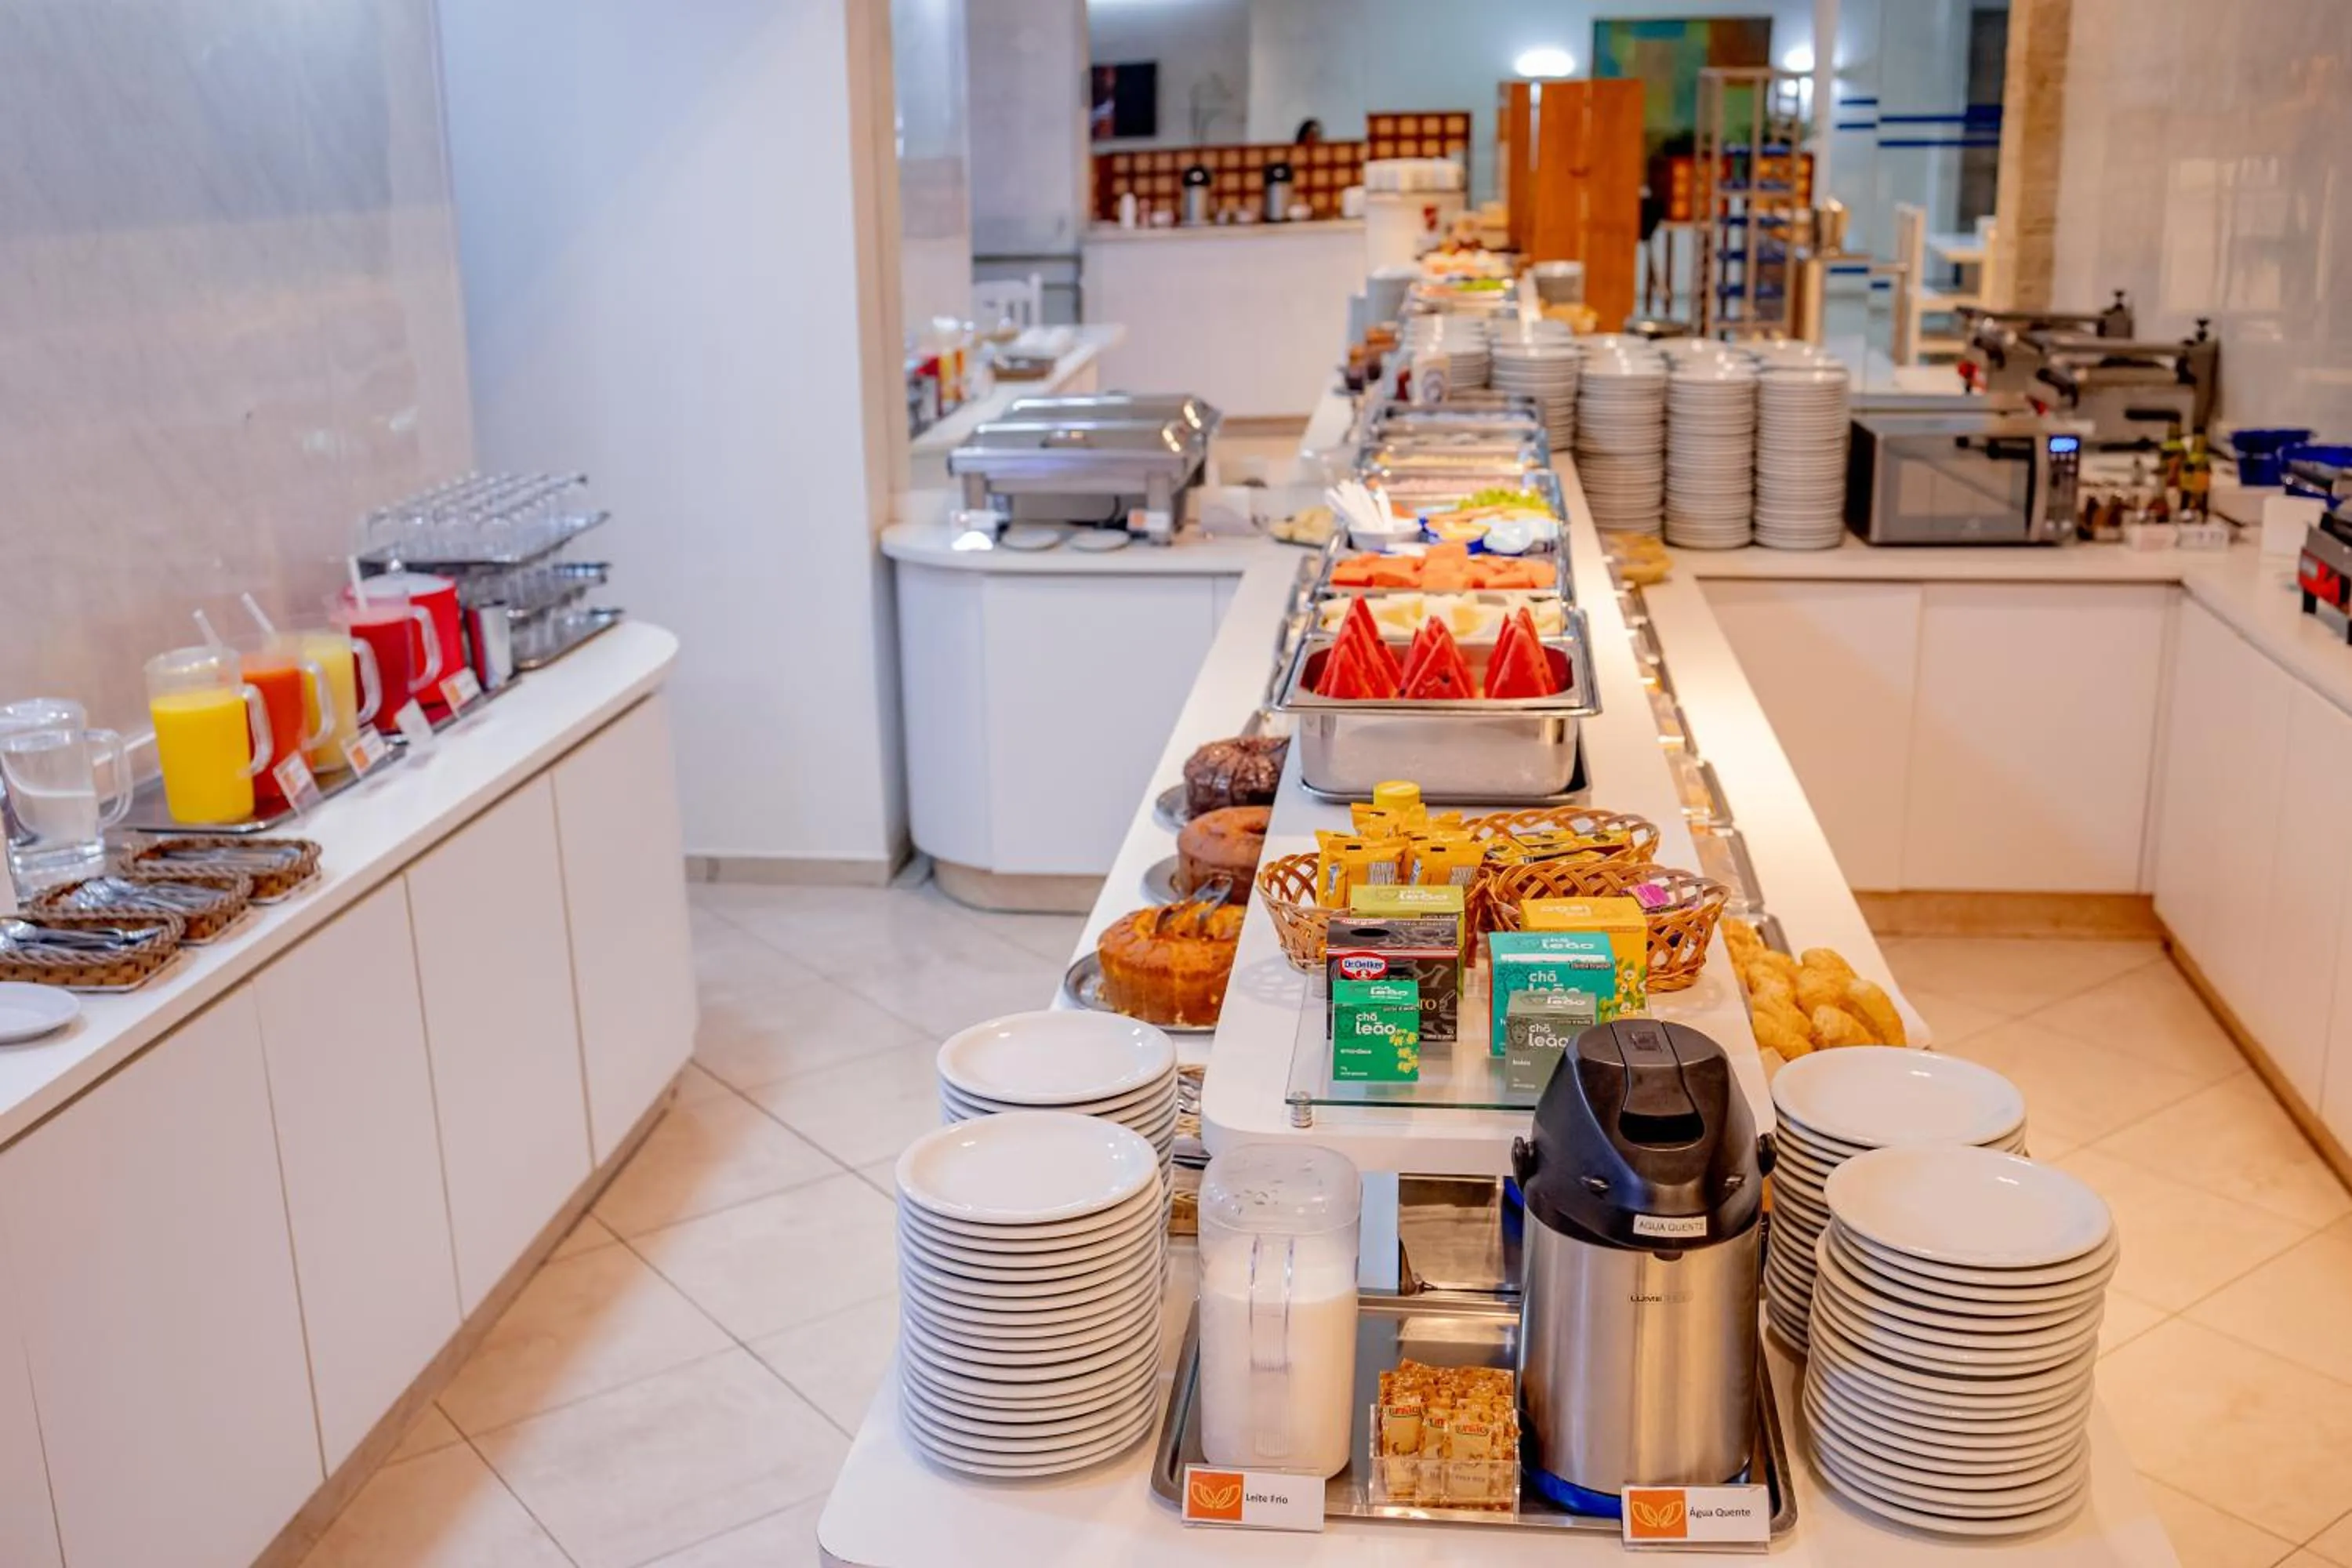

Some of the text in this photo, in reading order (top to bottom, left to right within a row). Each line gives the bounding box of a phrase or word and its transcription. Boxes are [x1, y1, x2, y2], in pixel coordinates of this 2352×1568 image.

[1356, 1021, 1396, 1035] leão
[1529, 1033, 1569, 1048] leão
[1668, 1222, 1704, 1232] QUENTE
[1246, 1493, 1288, 1504] Leite Frio
[1690, 1506, 1751, 1518] Água Quente
